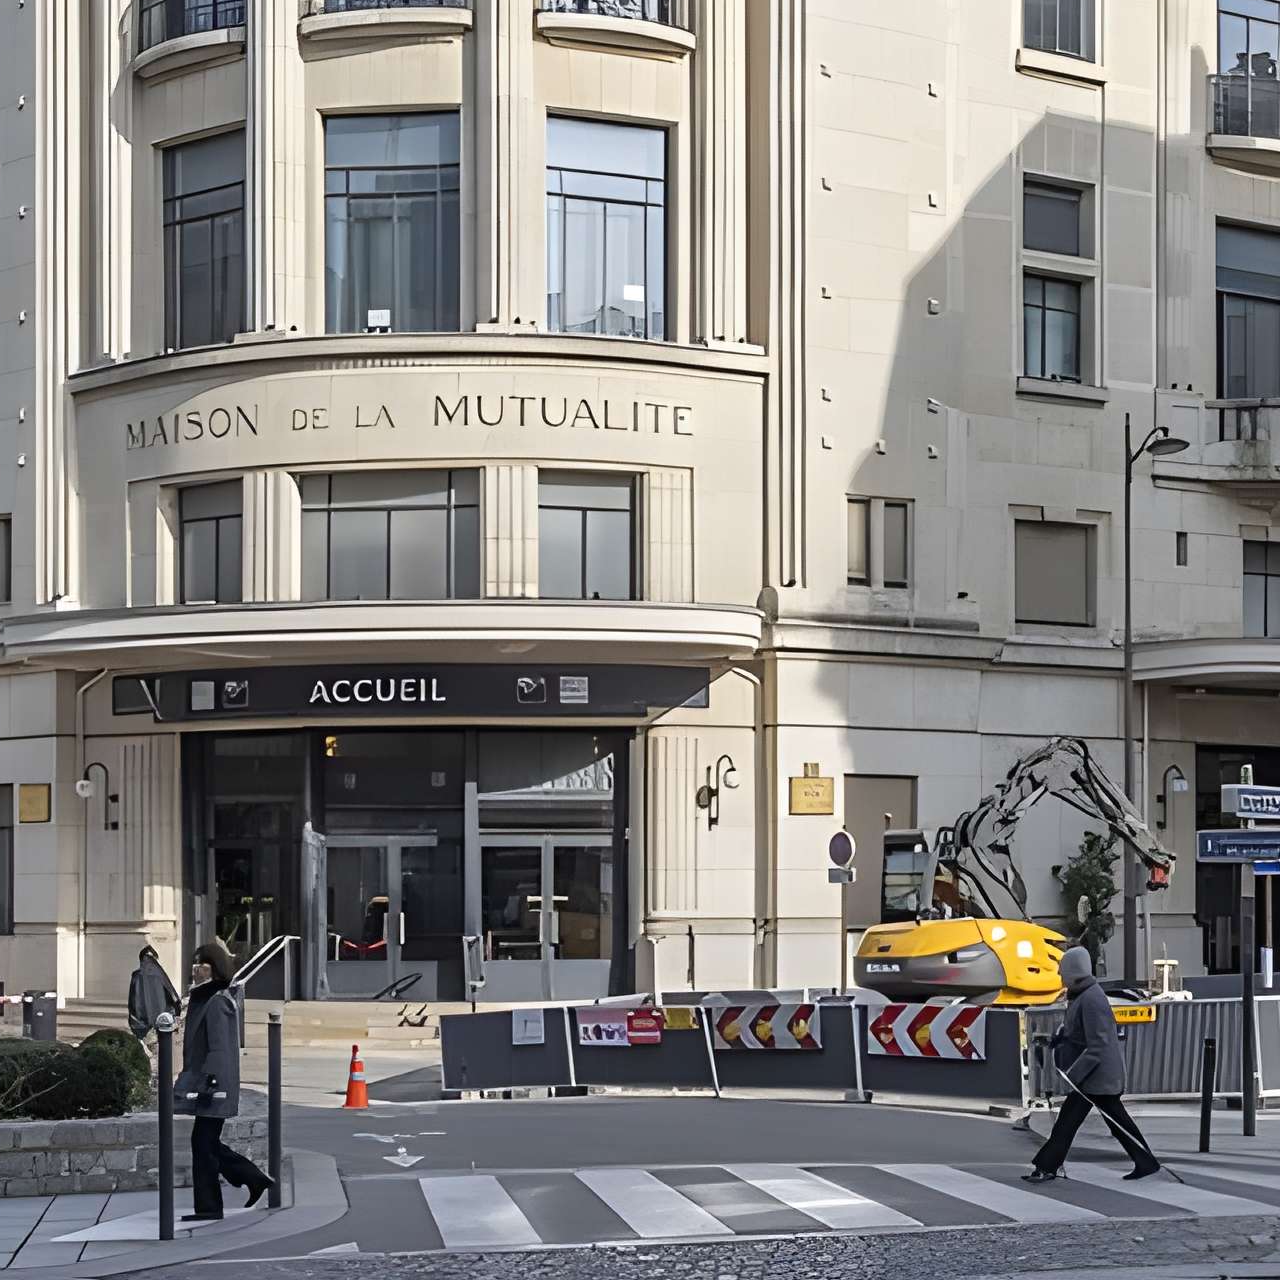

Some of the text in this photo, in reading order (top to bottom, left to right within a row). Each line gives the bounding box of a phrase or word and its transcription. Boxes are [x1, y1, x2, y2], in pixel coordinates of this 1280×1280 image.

[126, 395, 695, 451] MAISON DE LA MUTUALITE
[308, 677, 447, 704] ACCUEIL
